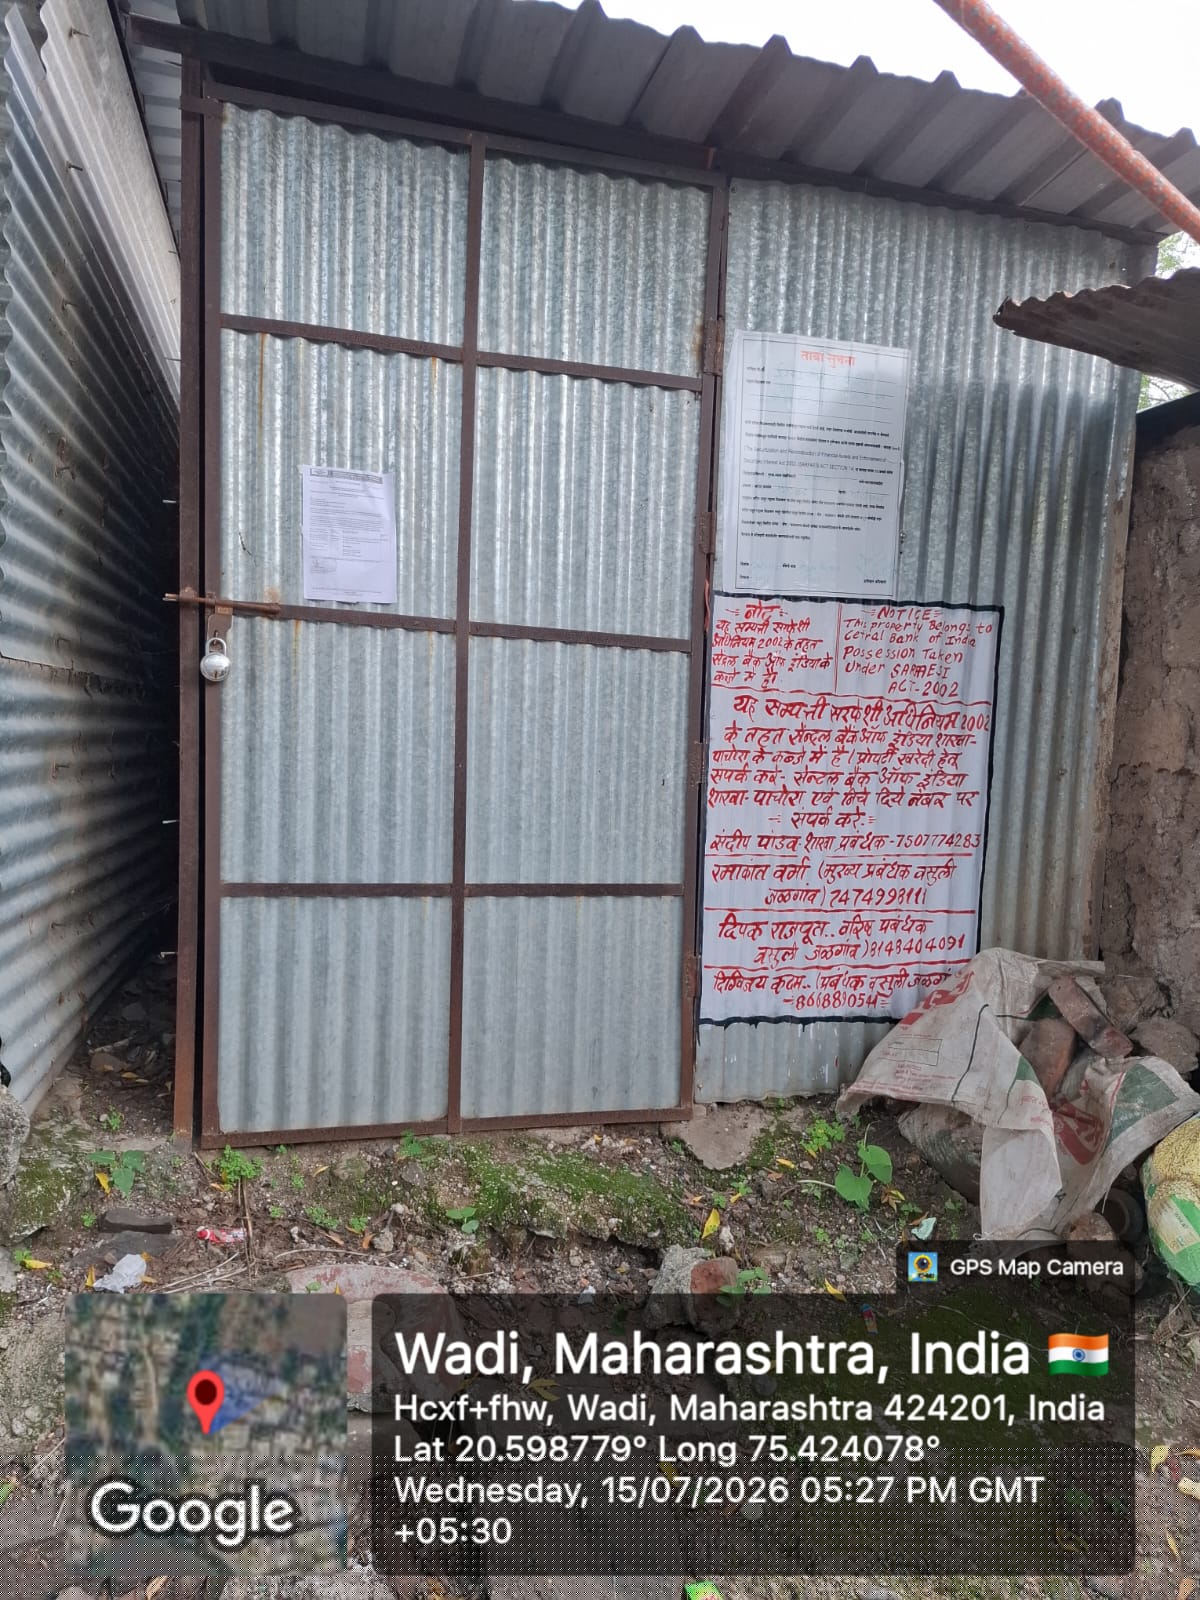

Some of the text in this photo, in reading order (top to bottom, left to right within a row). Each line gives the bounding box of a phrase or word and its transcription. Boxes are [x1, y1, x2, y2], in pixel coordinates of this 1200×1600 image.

[877, 606, 932, 621] NOTICE
[976, 623, 993, 634] to
[890, 633, 919, 644] Bank
[929, 632, 943, 644] of
[843, 645, 964, 665] Possession Taken
[733, 695, 759, 722] यह
[724, 720, 743, 743] के
[745, 727, 789, 747] तहत
[956, 791, 980, 807] पर
